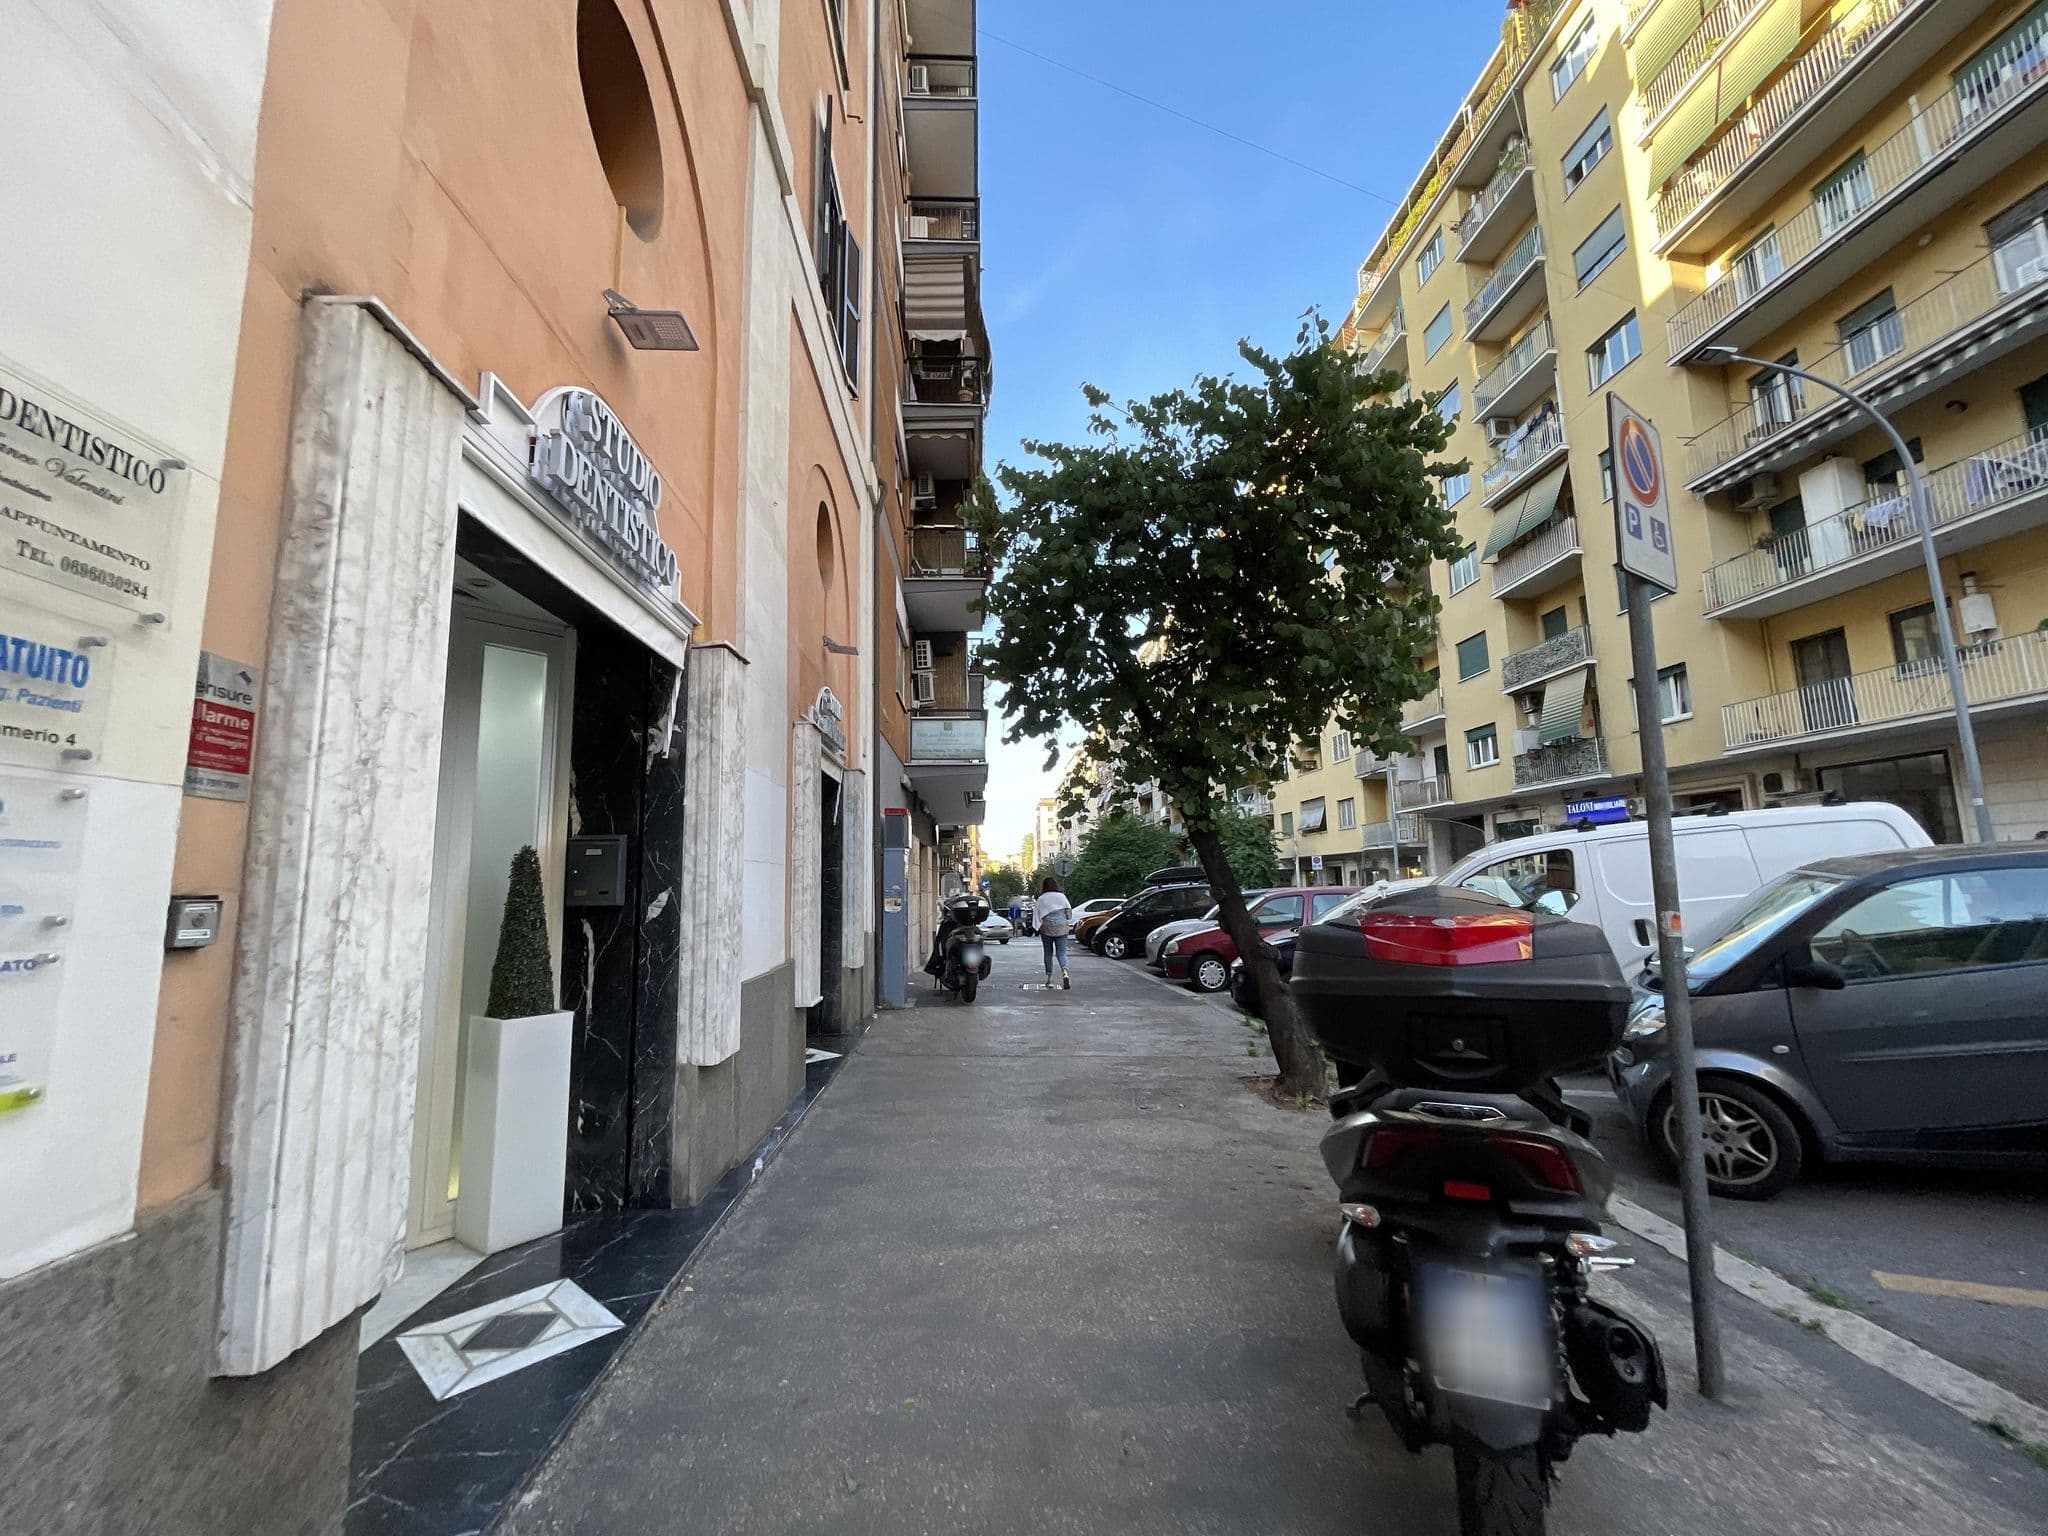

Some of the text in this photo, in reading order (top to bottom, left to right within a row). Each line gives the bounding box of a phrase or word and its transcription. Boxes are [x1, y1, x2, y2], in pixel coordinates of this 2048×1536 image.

[0, 387, 166, 495] DENTISTICO
[581, 395, 662, 510] STUDIO
[0, 506, 150, 571] APPUNTAMENTO
[550, 428, 678, 586] DENTISTICO
[0, 723, 77, 746] merio 4
[1567, 801, 1594, 814] TALONI
